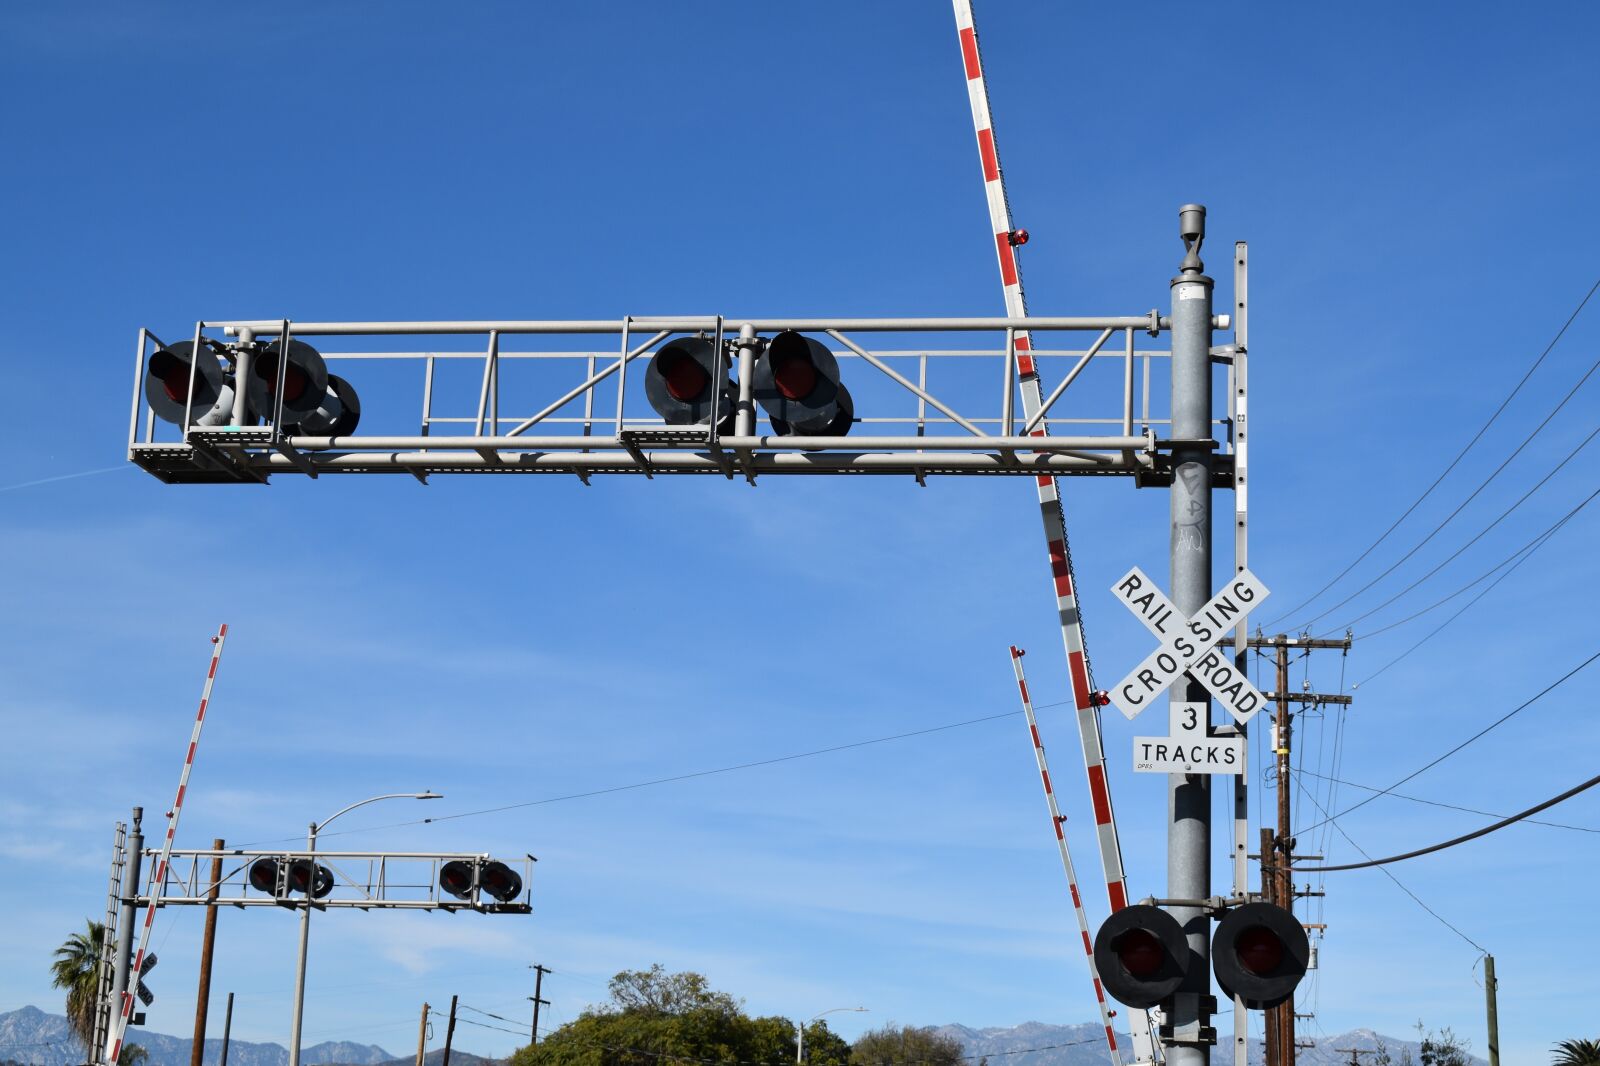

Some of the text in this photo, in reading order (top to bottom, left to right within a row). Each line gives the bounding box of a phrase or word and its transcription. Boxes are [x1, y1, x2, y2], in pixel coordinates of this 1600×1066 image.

[1118, 574, 1258, 714] RAIL ROAD
[1122, 582, 1255, 705] CROSSING
[1141, 743, 1236, 765] TRACKS
[1181, 706, 1198, 731] 3
